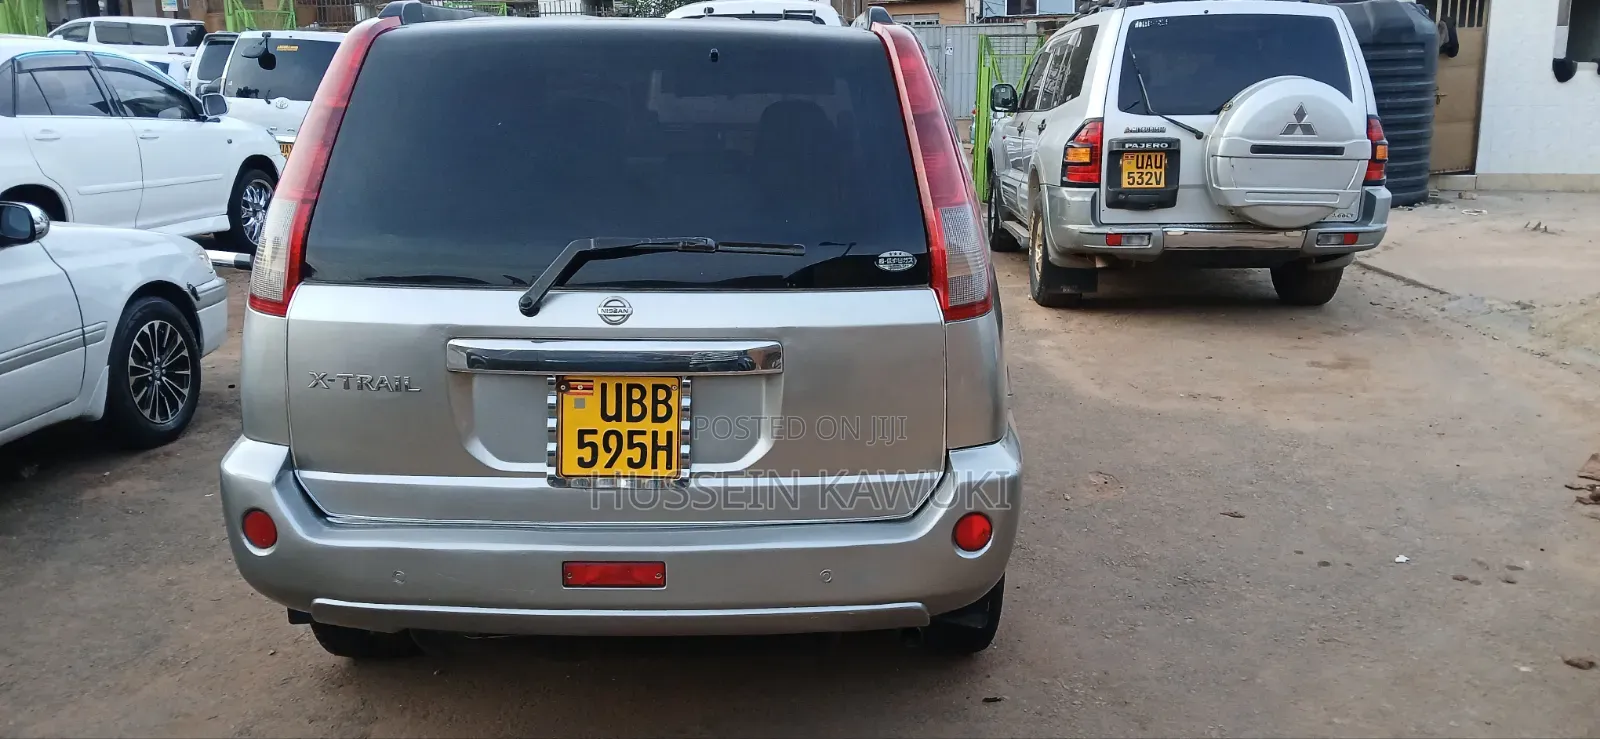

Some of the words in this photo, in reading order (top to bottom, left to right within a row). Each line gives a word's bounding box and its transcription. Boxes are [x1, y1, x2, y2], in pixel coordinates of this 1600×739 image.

[1135, 154, 1163, 170] UAU
[1127, 171, 1163, 186] 532V
[600, 382, 673, 424] UBB
[576, 428, 673, 471] 595H
